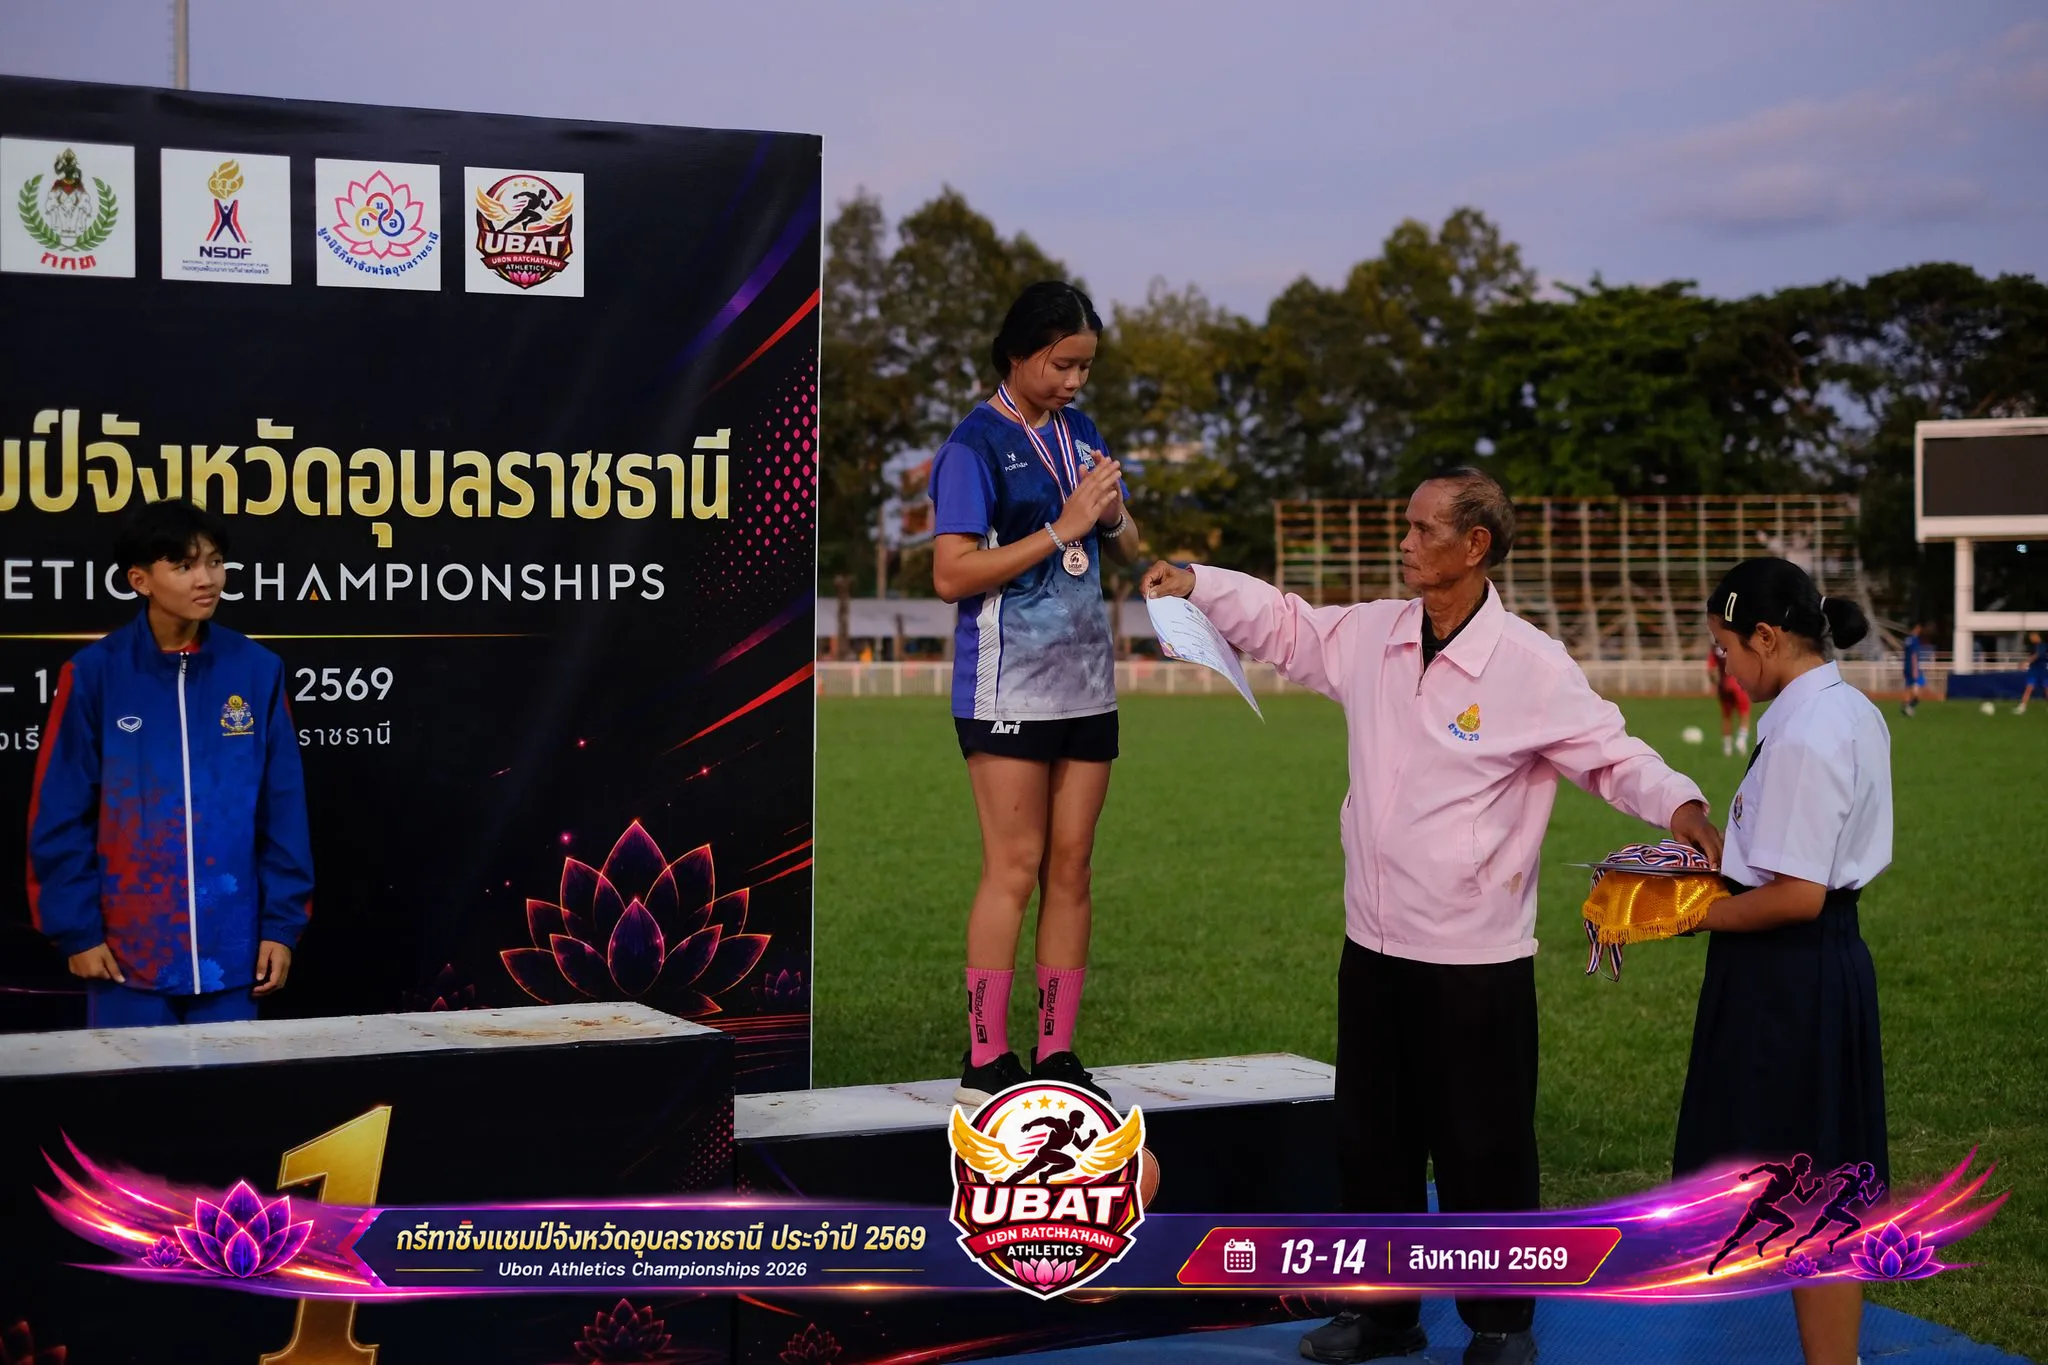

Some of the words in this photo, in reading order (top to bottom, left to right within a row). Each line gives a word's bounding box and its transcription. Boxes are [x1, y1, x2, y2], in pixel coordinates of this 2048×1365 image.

[484, 232, 566, 257] UBAT
[199, 246, 252, 260] NSDF
[491, 256, 512, 265] UBON
[512, 255, 561, 268] RATCHATHANI
[505, 264, 546, 272] ATHLETICS
[220, 562, 666, 602] CHAMPIONSHIPS
[295, 666, 394, 702] 2569
[990, 720, 1021, 735] Ari
